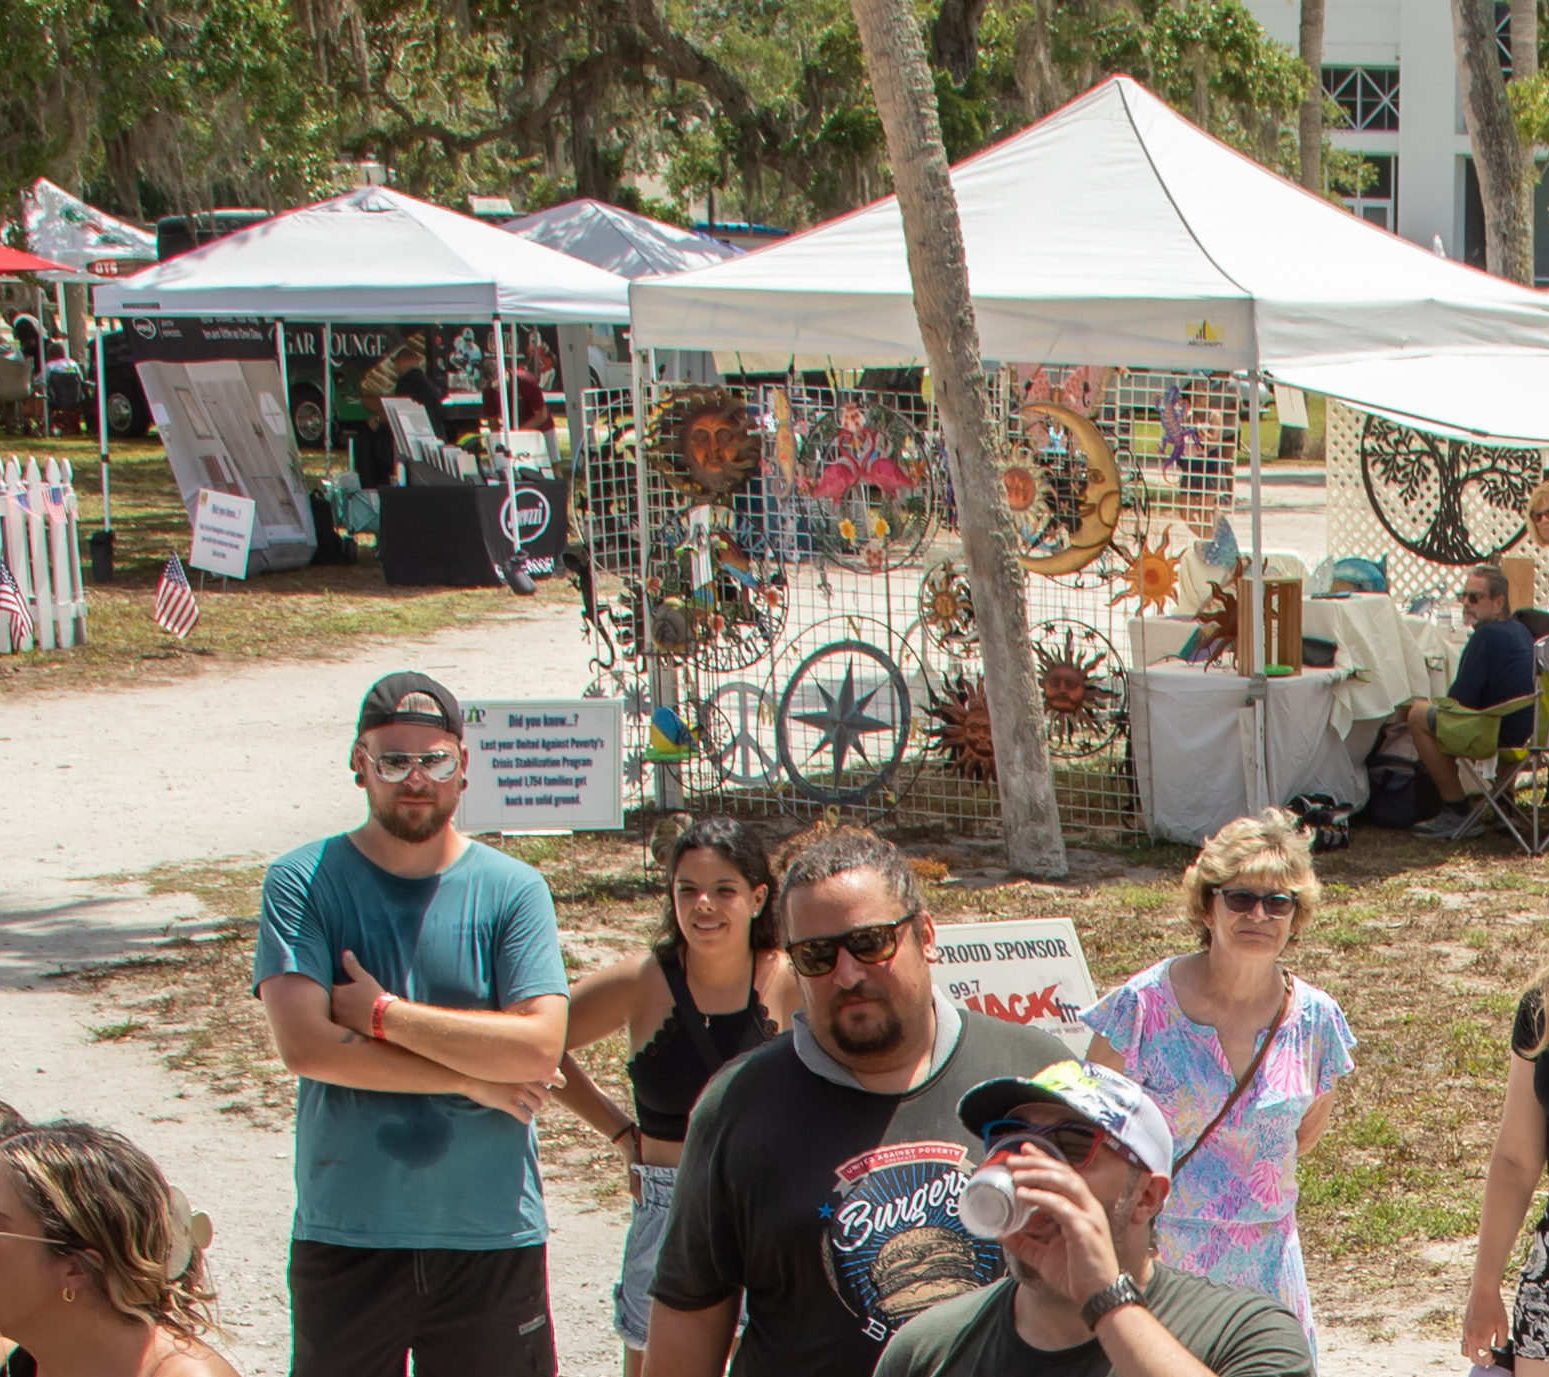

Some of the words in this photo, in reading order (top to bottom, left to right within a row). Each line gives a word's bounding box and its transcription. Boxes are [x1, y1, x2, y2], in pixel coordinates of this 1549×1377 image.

[509, 714, 523, 728] Did
[525, 717, 541, 731] you
[480, 739, 496, 751] Last
[498, 742, 515, 752] year
[516, 739, 540, 750] United
[541, 739, 569, 752] Against
[570, 737, 605, 751] Poverty's
[492, 757, 513, 769] Crisis
[514, 756, 560, 769] Stabilization
[562, 756, 593, 770] Program
[498, 776, 523, 789] helped
[543, 775, 574, 787] families
[574, 776, 587, 788] get
[505, 795, 522, 806] back
[524, 796, 534, 806] on
[535, 794, 552, 806] solid
[936, 942, 992, 965] PROUD
[993, 938, 1073, 962] SPONSOR
[949, 979, 981, 1001] 99.7
[964, 983, 1063, 1025] JACK
[846, 1157, 875, 1175] UNITED
[877, 1148, 916, 1161] AGAINST
[918, 1147, 961, 1157] POVERTY
